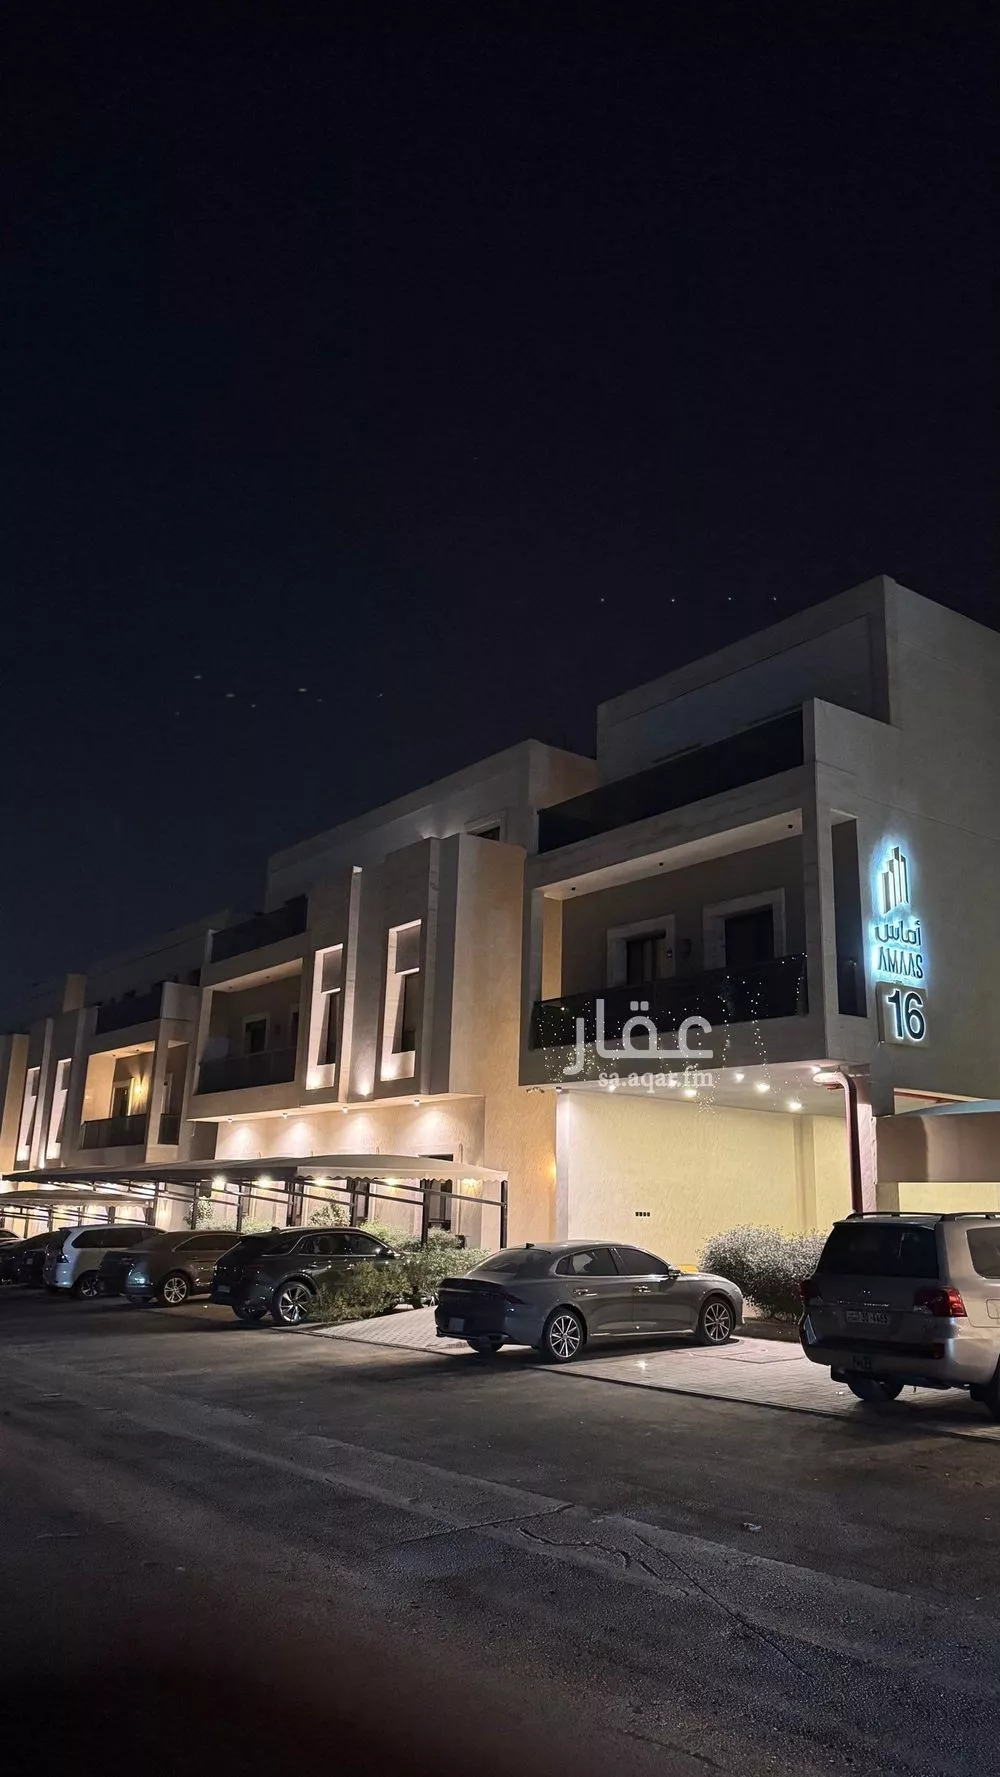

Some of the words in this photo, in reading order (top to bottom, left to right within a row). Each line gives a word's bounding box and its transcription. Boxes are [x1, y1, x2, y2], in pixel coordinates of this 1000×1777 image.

[874, 919, 922, 946] أماس
[877, 946, 924, 979] AMAAS
[887, 988, 926, 1041] 16
